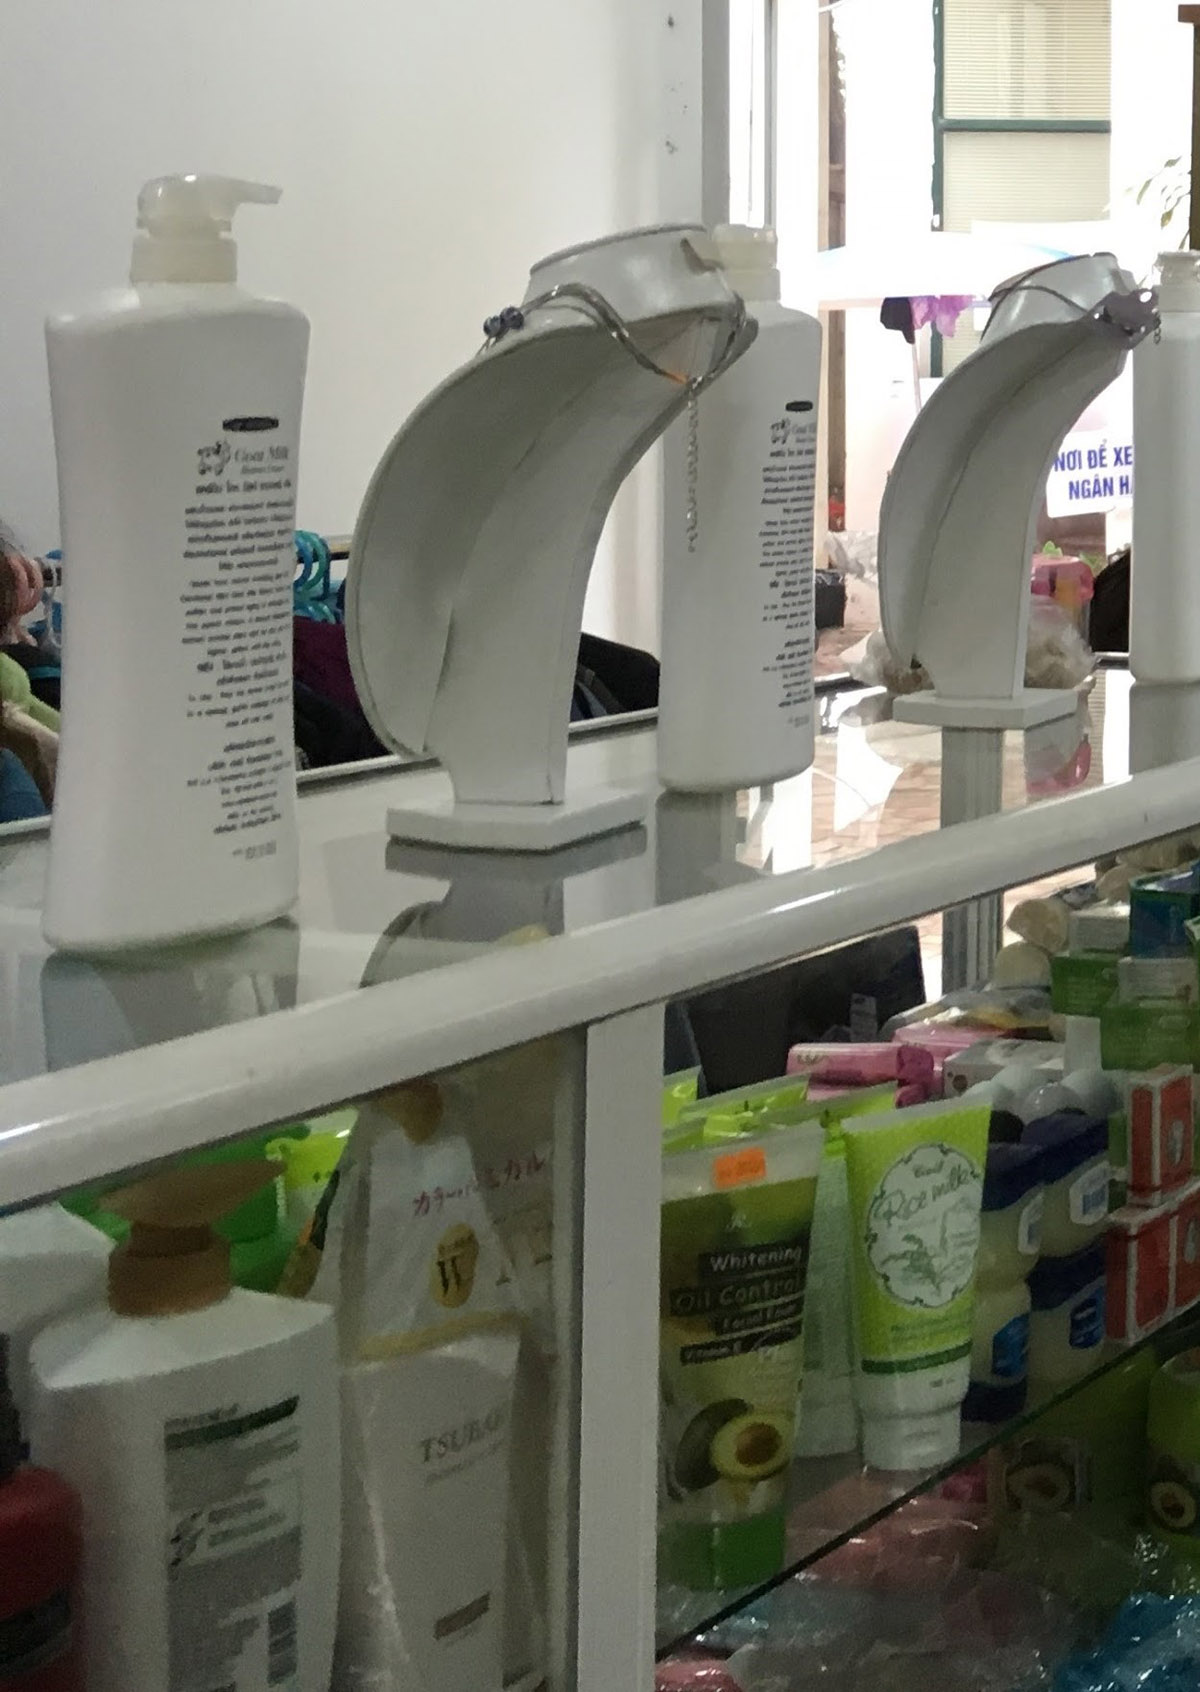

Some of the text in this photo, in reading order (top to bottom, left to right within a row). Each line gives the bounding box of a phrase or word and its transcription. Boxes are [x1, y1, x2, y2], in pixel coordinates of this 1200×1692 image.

[1054, 439, 1133, 472] NƠI ĐỂ XE
[1068, 473, 1133, 500] NGÂN H
[710, 1246, 802, 1272] Whitening
[675, 1274, 801, 1314] Oil Control
